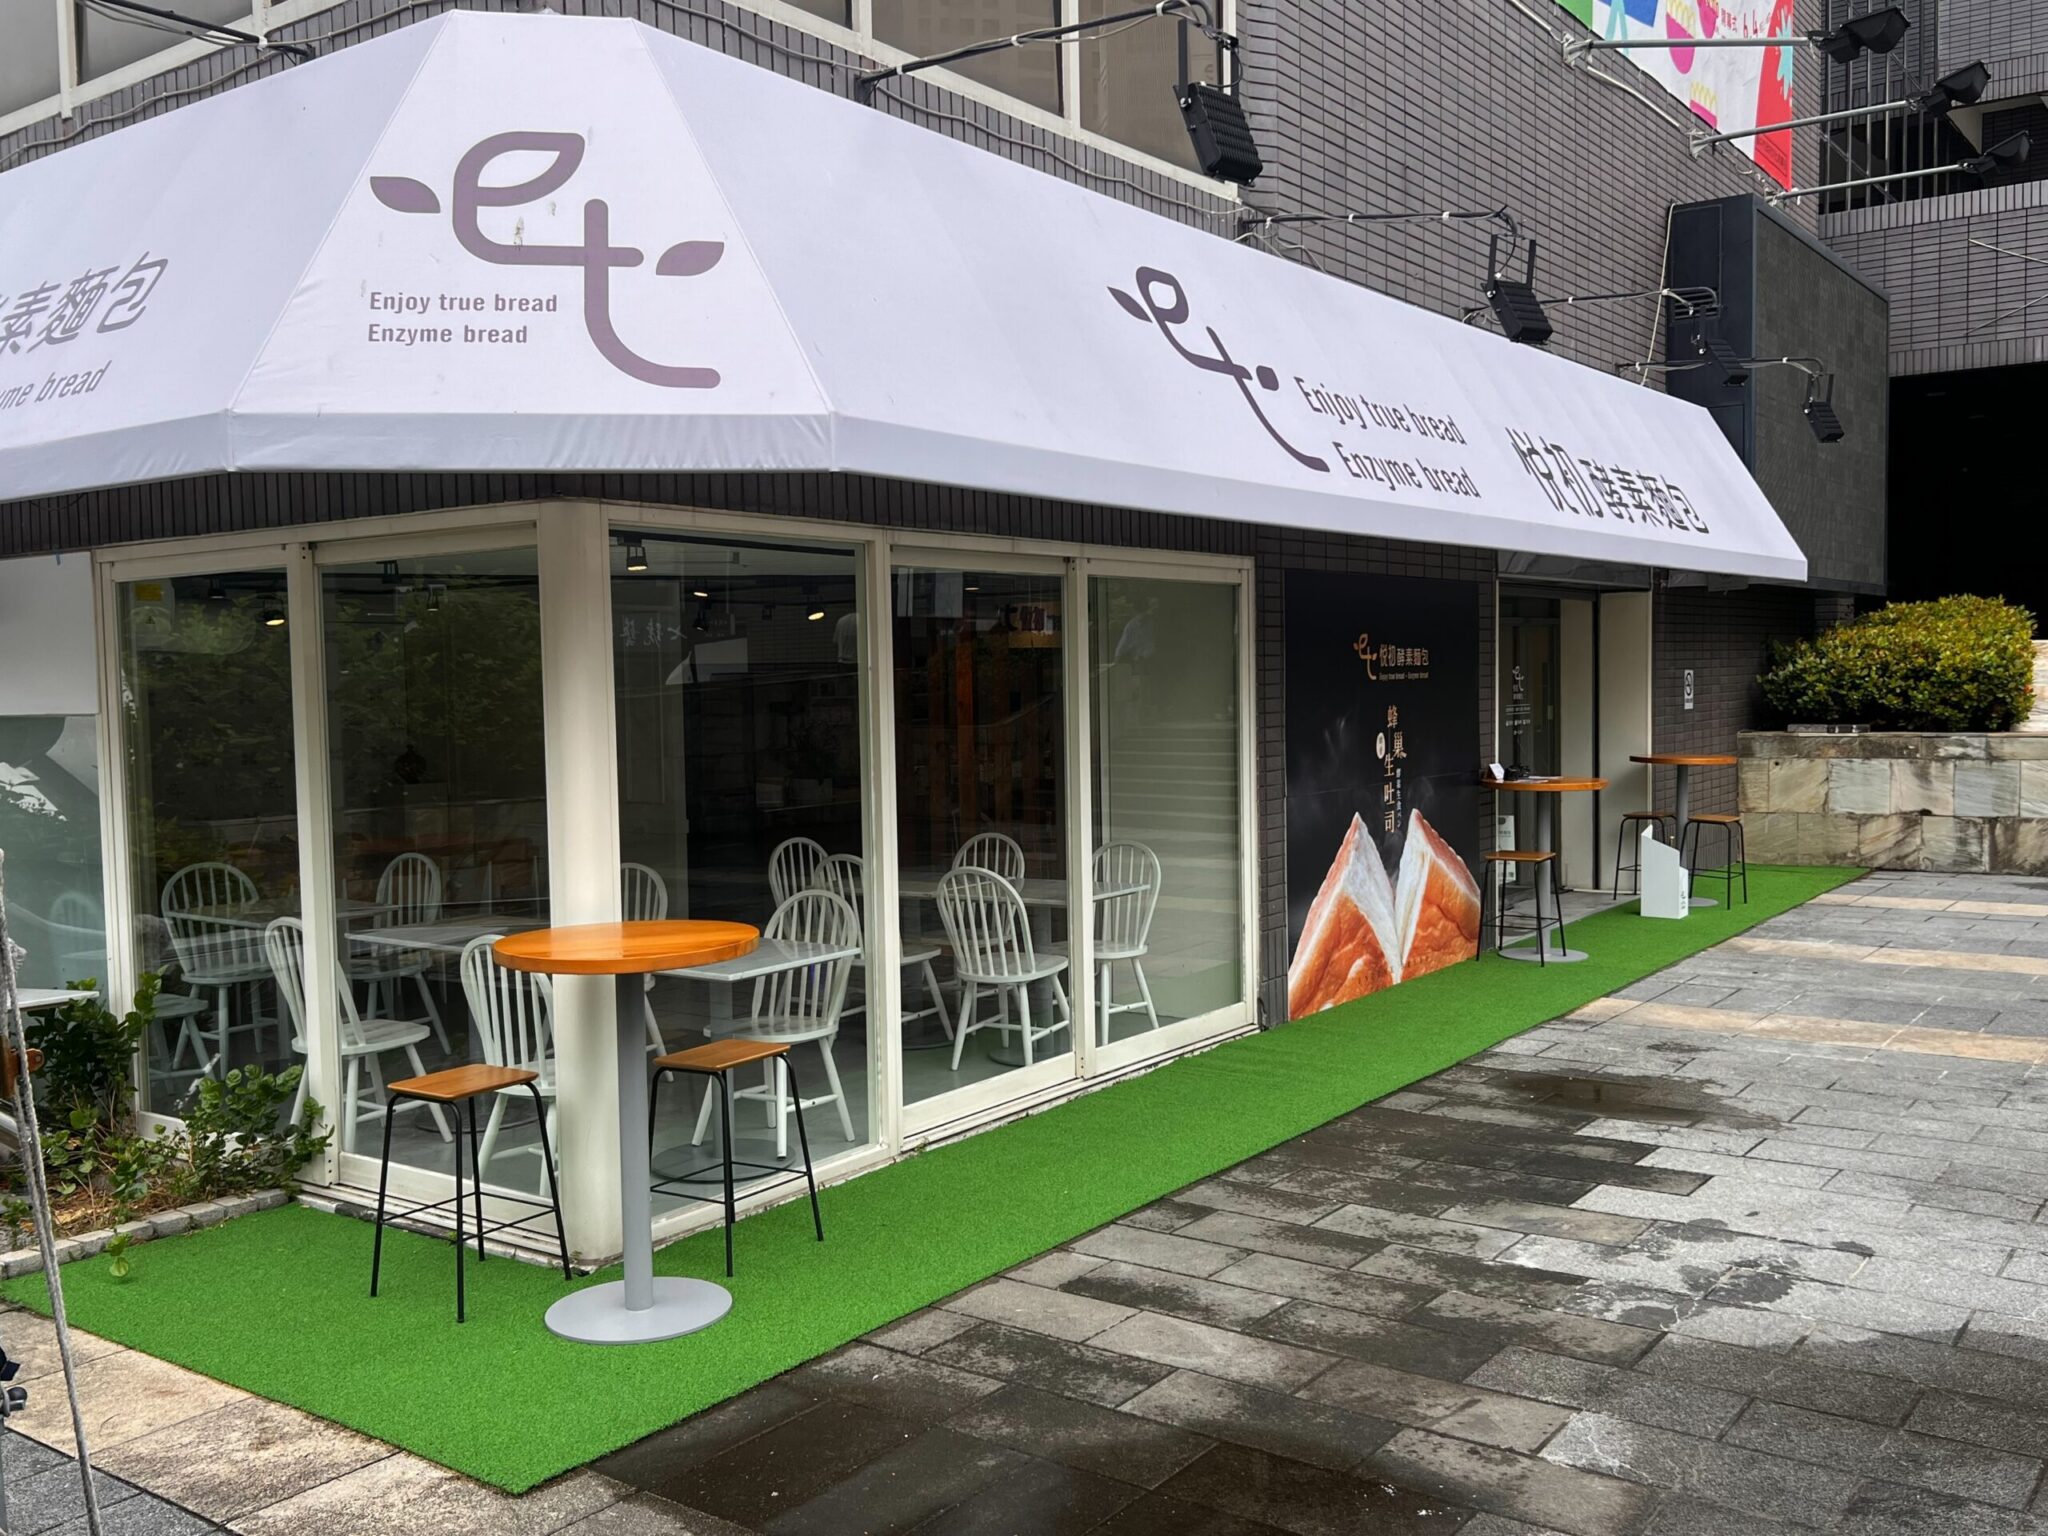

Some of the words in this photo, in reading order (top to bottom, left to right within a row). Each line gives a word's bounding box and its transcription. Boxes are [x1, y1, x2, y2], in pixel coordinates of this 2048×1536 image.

[0, 250, 168, 354] 素麵包
[370, 292, 430, 314] Enjoy
[439, 293, 485, 311] true
[494, 294, 557, 312] bread
[368, 323, 453, 346] Enzyme
[464, 324, 528, 343] bread
[34, 359, 112, 403] bread
[1293, 376, 1367, 430] Enjoy
[1359, 394, 1411, 433] true
[1403, 403, 1467, 446] bread
[1332, 441, 1423, 491] Enzyme
[1416, 457, 1481, 499] bread
